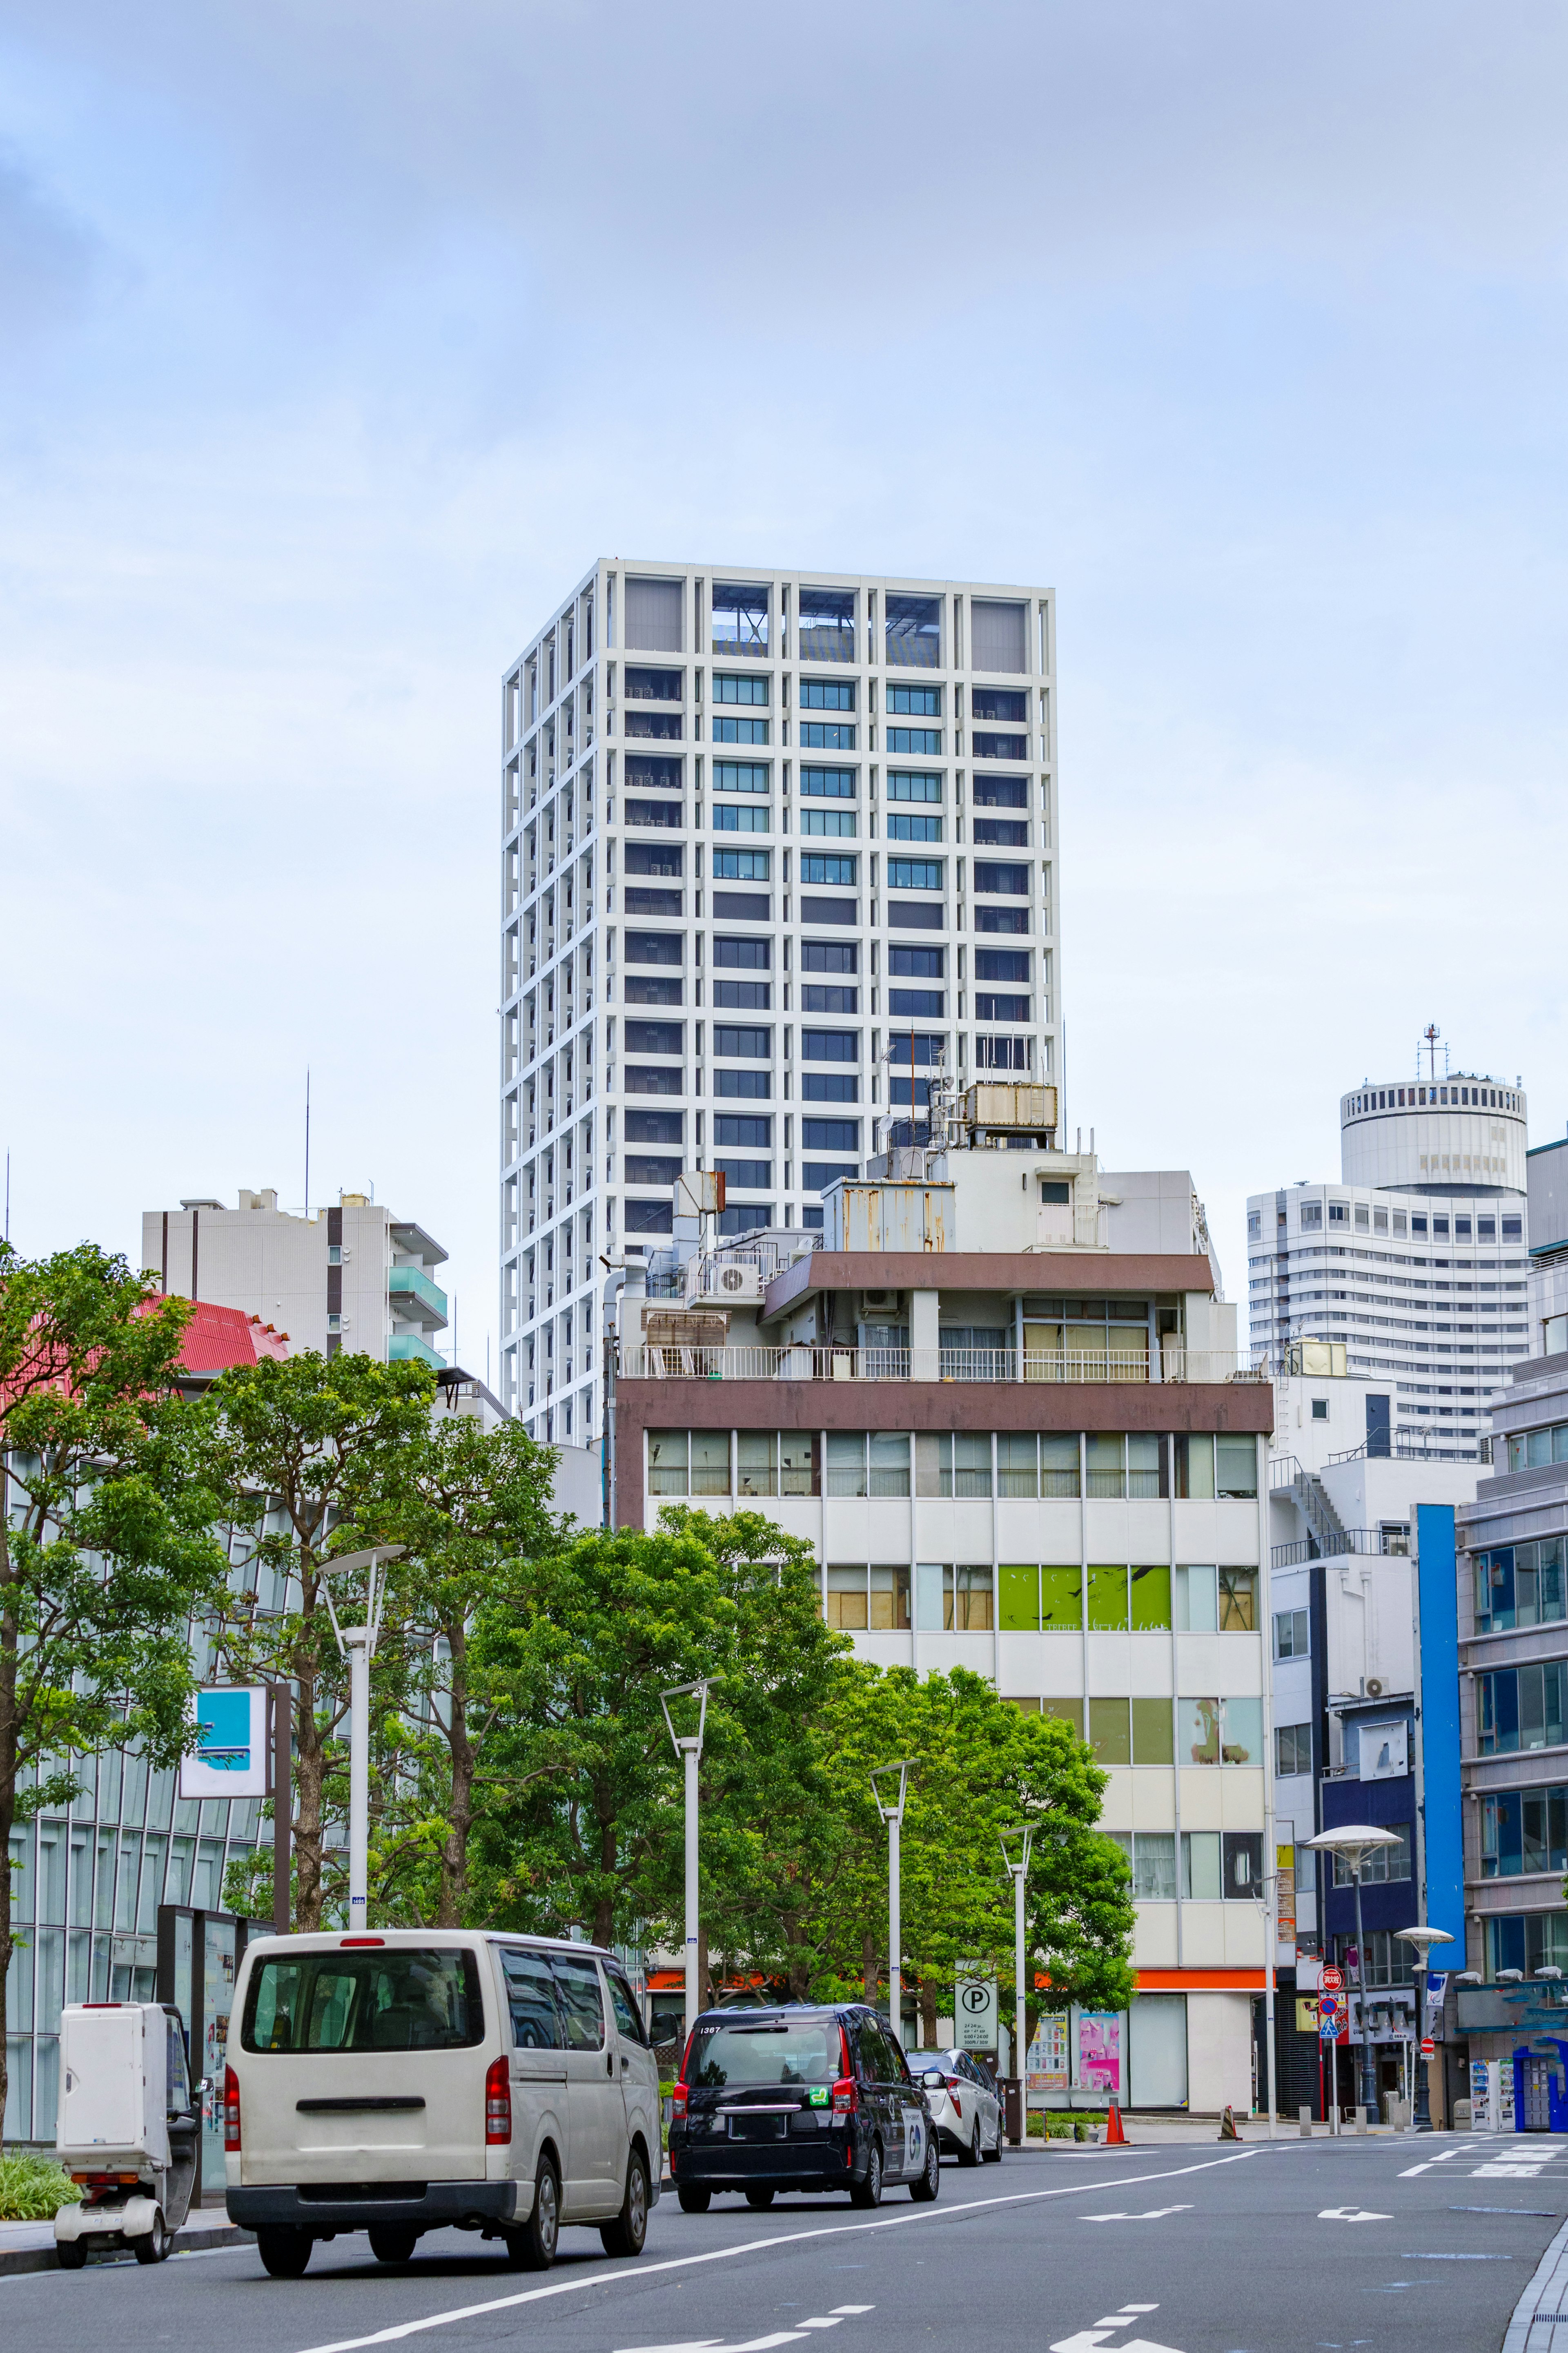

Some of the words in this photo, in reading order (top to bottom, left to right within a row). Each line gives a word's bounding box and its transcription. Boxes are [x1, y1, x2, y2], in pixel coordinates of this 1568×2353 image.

[1324, 1976, 1339, 1984] 消火栓
[971, 1991, 983, 2009] P
